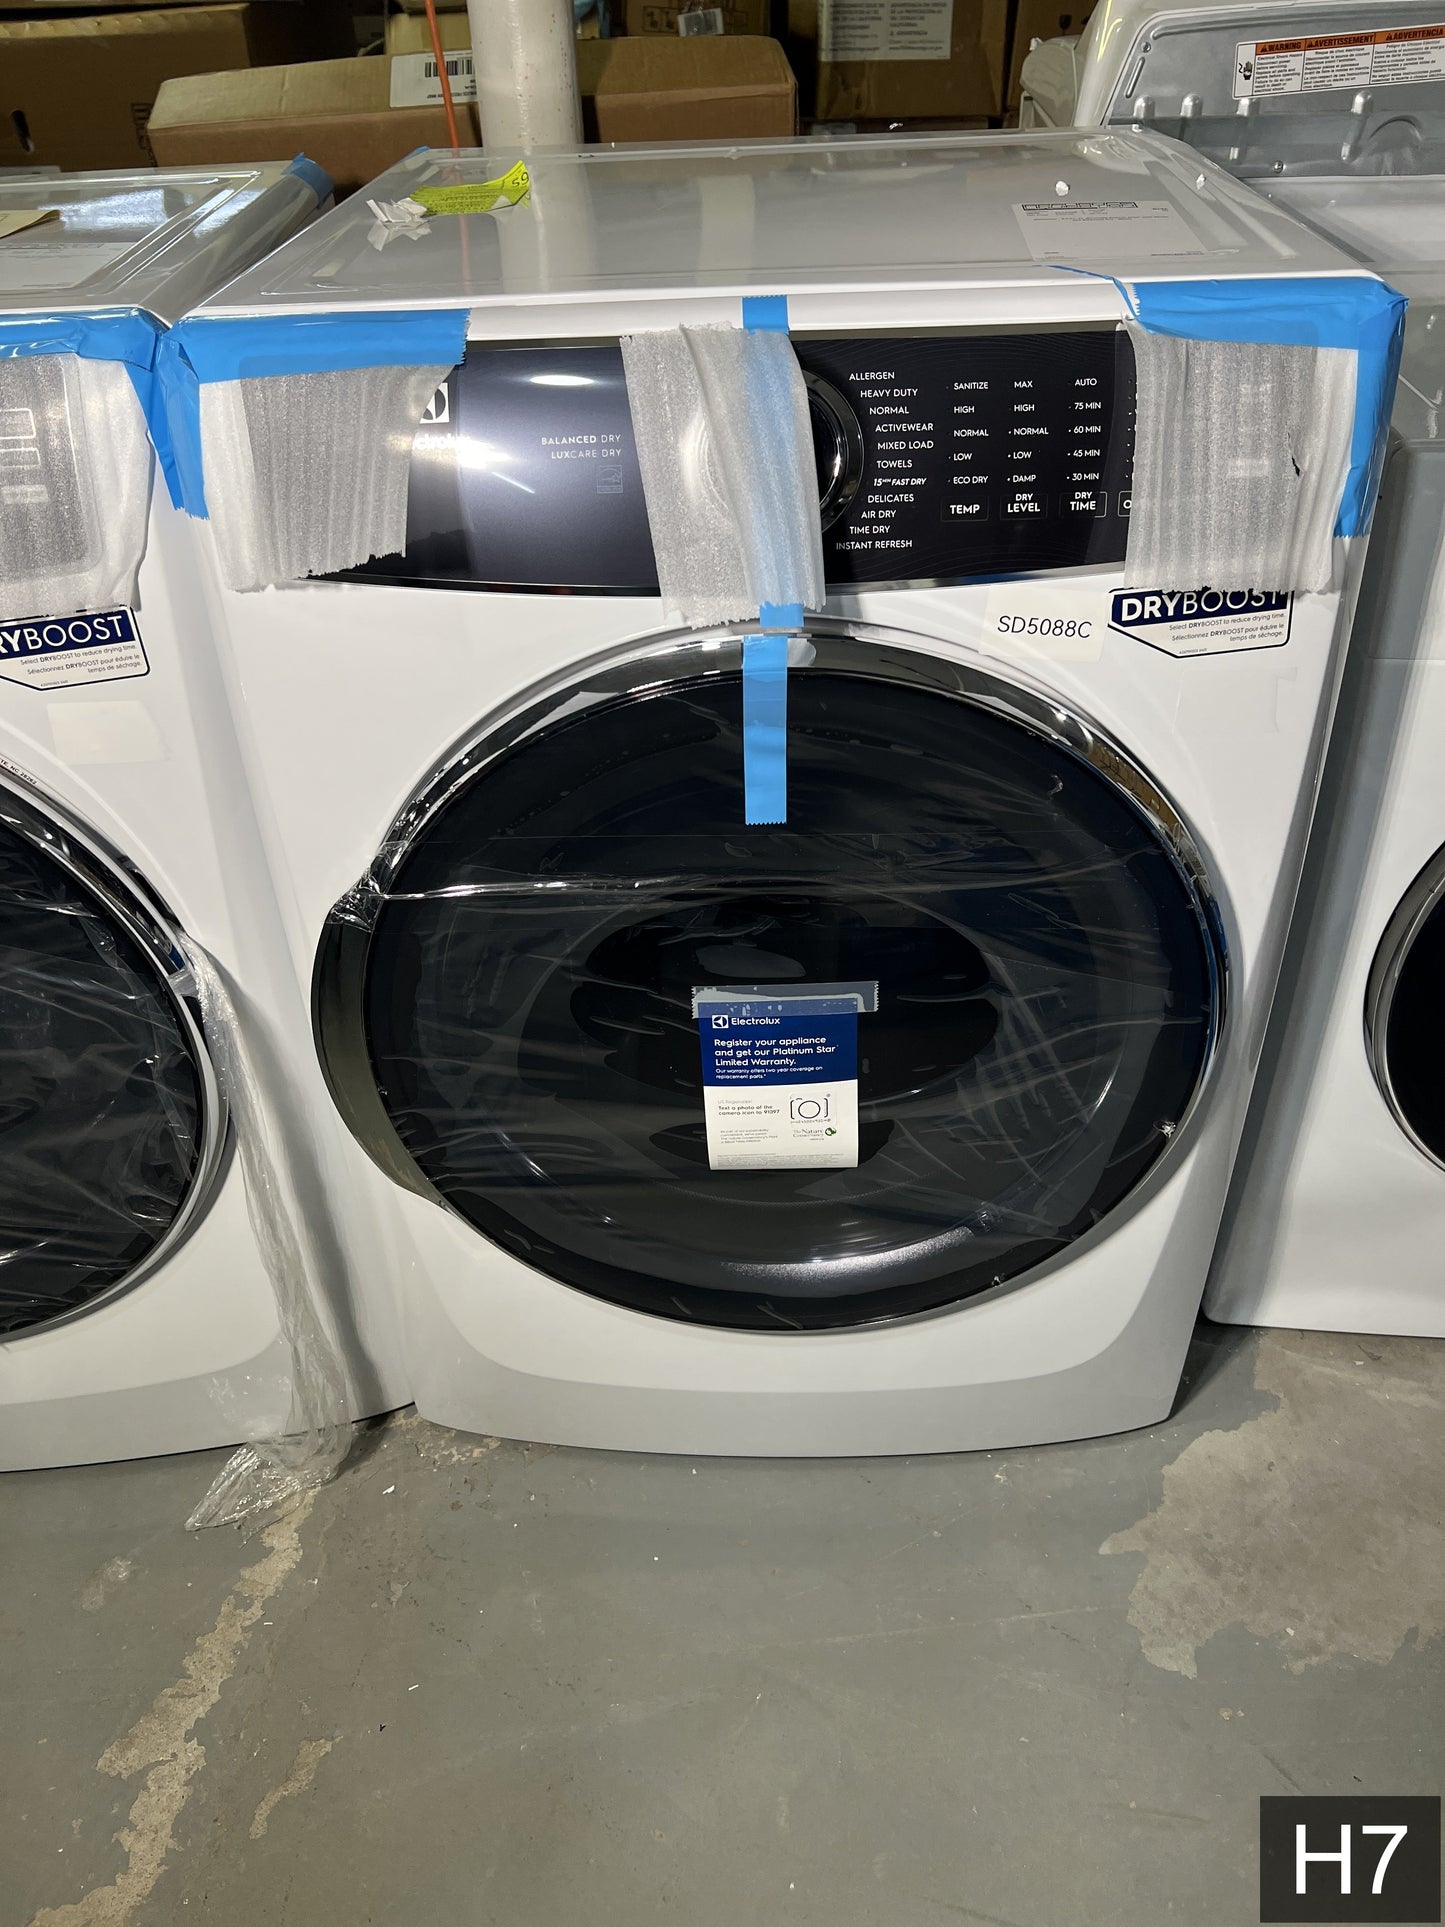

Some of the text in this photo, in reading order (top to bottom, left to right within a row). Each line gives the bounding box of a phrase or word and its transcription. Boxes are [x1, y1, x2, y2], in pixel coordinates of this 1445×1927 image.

[1394, 28, 1443, 40] ADVERTENCIA
[1315, 35, 1373, 47] AVERTISSEMENT
[1268, 42, 1301, 51] WARNING
[849, 372, 894, 380] ALLERGEN
[954, 382, 988, 390] SANITIZE
[1075, 378, 1097, 386] AUTO
[860, 388, 918, 398] HEAVY DUTY
[870, 406, 909, 415] NORMAL
[954, 406, 974, 414] HIGH
[1014, 404, 1035, 412] HIGH
[1074, 402, 1102, 410] 75 MIN
[875, 423, 934, 432] ACTIVEWEAR
[1013, 427, 1048, 435] NORMAL
[1074, 425, 1101, 434] 60 MIN
[954, 429, 989, 437] NORMAL
[542, 434, 622, 446] BALANCED DRY
[878, 440, 934, 450] MIXED LOAD
[551, 448, 622, 459] LUXCARE DRY
[954, 453, 972, 461] LOW
[1013, 451, 1032, 459] LOW
[1072, 449, 1100, 458] 45 MIN
[876, 460, 912, 468] TOWELS
[953, 476, 988, 485] ECO DRY
[1012, 475, 1036, 483] DAMP
[1072, 473, 1082, 481] 30
[892, 478, 909, 486] FAST
[910, 478, 927, 486] DRY
[868, 494, 914, 504] DELICATES
[1016, 494, 1034, 502] DRY
[1075, 491, 1092, 500] DRY
[950, 504, 980, 514] TEMP
[1007, 502, 1040, 512] LEVEL
[1070, 501, 1096, 510] TIME
[861, 510, 896, 519] AIR DRY
[849, 526, 890, 534] TIME DRY
[836, 540, 913, 550] INSTANT REFRESH
[1188, 620, 1222, 629] DRYBOOST
[1252, 614, 1270, 623] drying
[997, 615, 1093, 638] SD5088C
[1172, 632, 1208, 641] Sélectionnez
[1210, 628, 1244, 637] DRYBOOST
[1258, 630, 1282, 639] séchage.
[20, 658, 39, 666] Select
[40, 652, 74, 662] DRYBOOST
[82, 649, 102, 657] reduce
[104, 646, 122, 655] drying
[27, 666, 64, 675] Sélectionnez
[66, 660, 99, 670] DRYBOOST
[88, 666, 106, 674] temps
[10, 765, 20, 774] NC
[731, 1017, 780, 1026] Electrolux
[714, 1037, 826, 1048] Register your appliance
[714, 1048, 734, 1056] and
[736, 1048, 752, 1058] get
[773, 1047, 814, 1056] Platinum
[716, 1058, 796, 1067] Limited Warranty.
